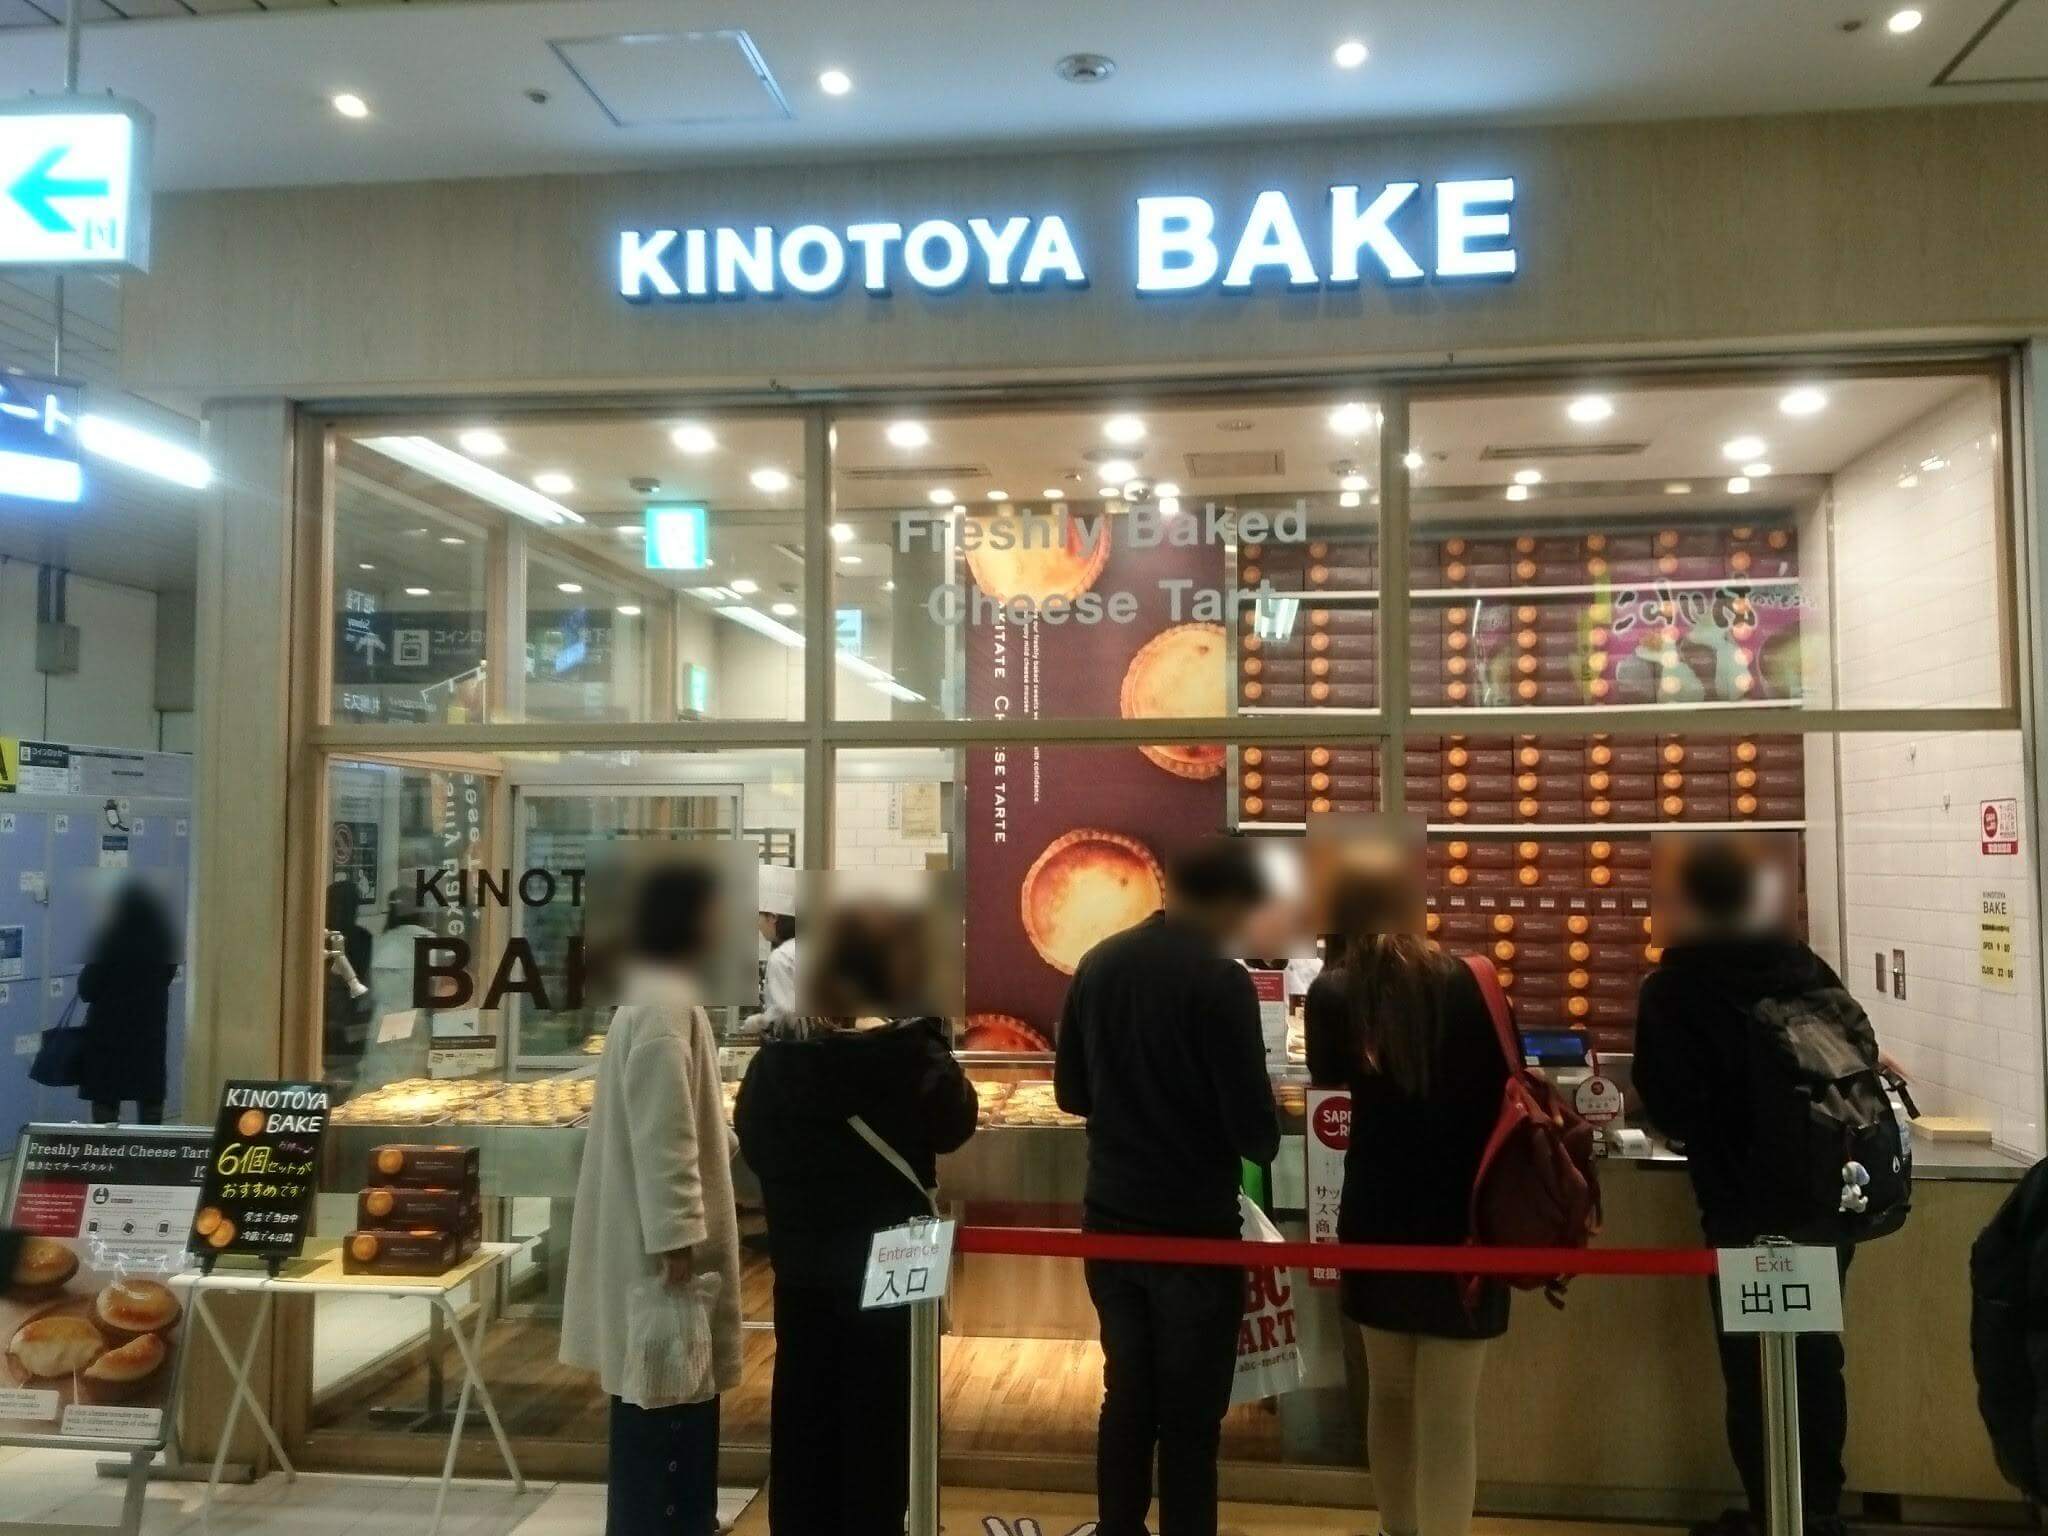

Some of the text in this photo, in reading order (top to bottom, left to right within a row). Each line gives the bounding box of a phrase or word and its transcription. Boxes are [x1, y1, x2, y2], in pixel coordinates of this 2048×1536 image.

[619, 177, 1518, 298] KINOTOYA BAKE
[901, 499, 1306, 557] Freshly Baked
[928, 578, 1277, 625] Cheese Tart
[995, 783, 1006, 843] TARTE
[416, 868, 585, 907] KINOT
[1983, 901, 2007, 915] BAKE
[226, 1088, 328, 1110] KINOTOYA
[265, 1114, 323, 1133] BAKE
[1340, 1125, 1350, 1137] R
[29, 1142, 210, 1159] Freshly Baked Cheese Tart
[878, 1243, 940, 1263] Entrance
[1755, 1255, 1794, 1272] Exit
[875, 1267, 929, 1302] 入口
[1741, 1281, 1811, 1315] 出口
